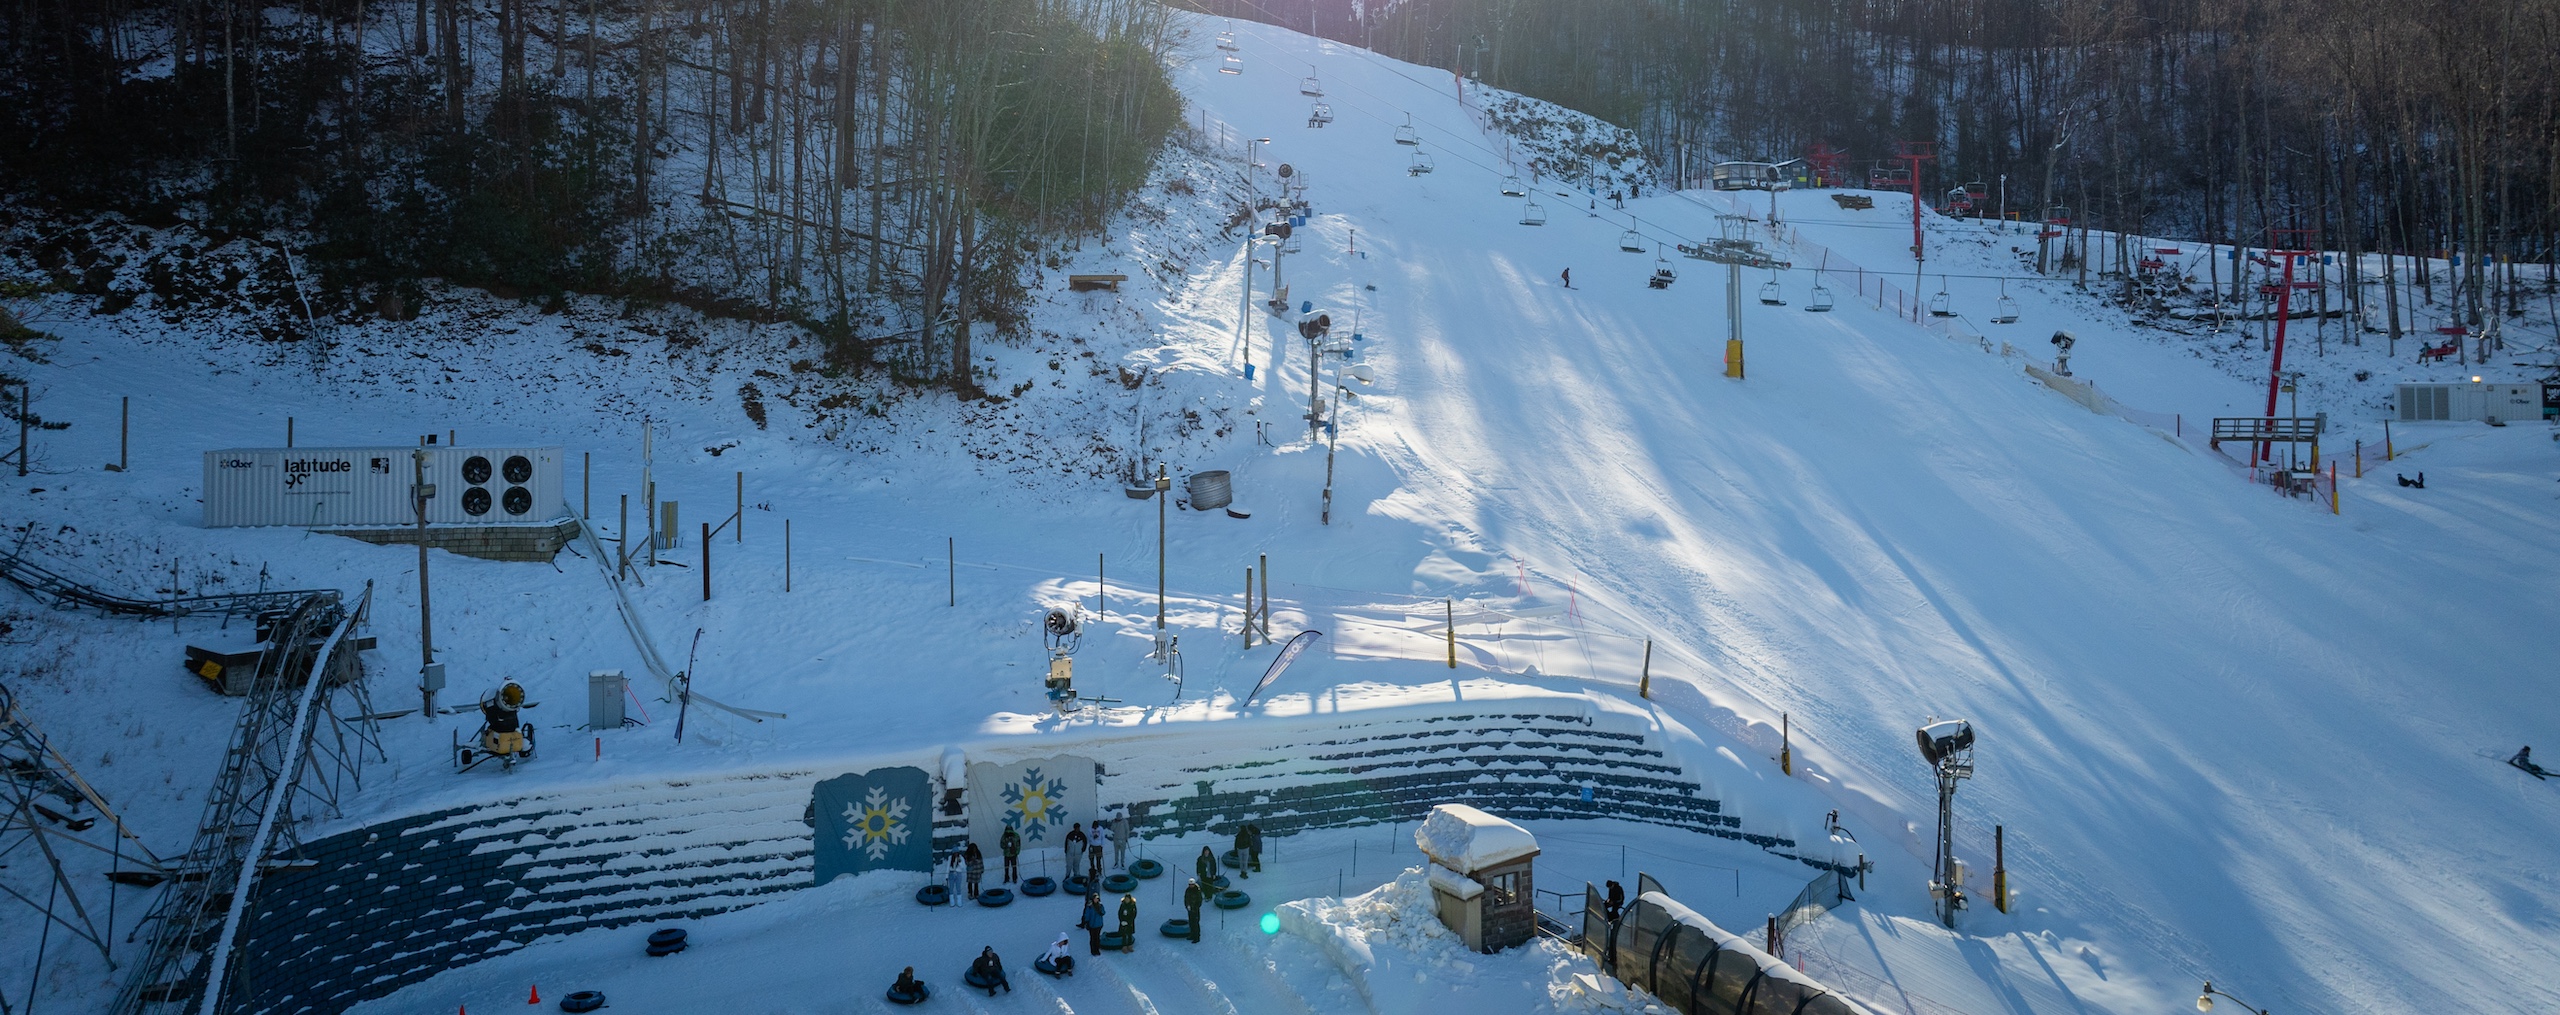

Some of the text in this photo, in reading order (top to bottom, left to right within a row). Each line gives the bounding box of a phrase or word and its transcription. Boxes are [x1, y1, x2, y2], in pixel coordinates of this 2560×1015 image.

[230, 459, 253, 468] Ober
[284, 458, 351, 473] latitude
[1291, 635, 1309, 654] Ober
